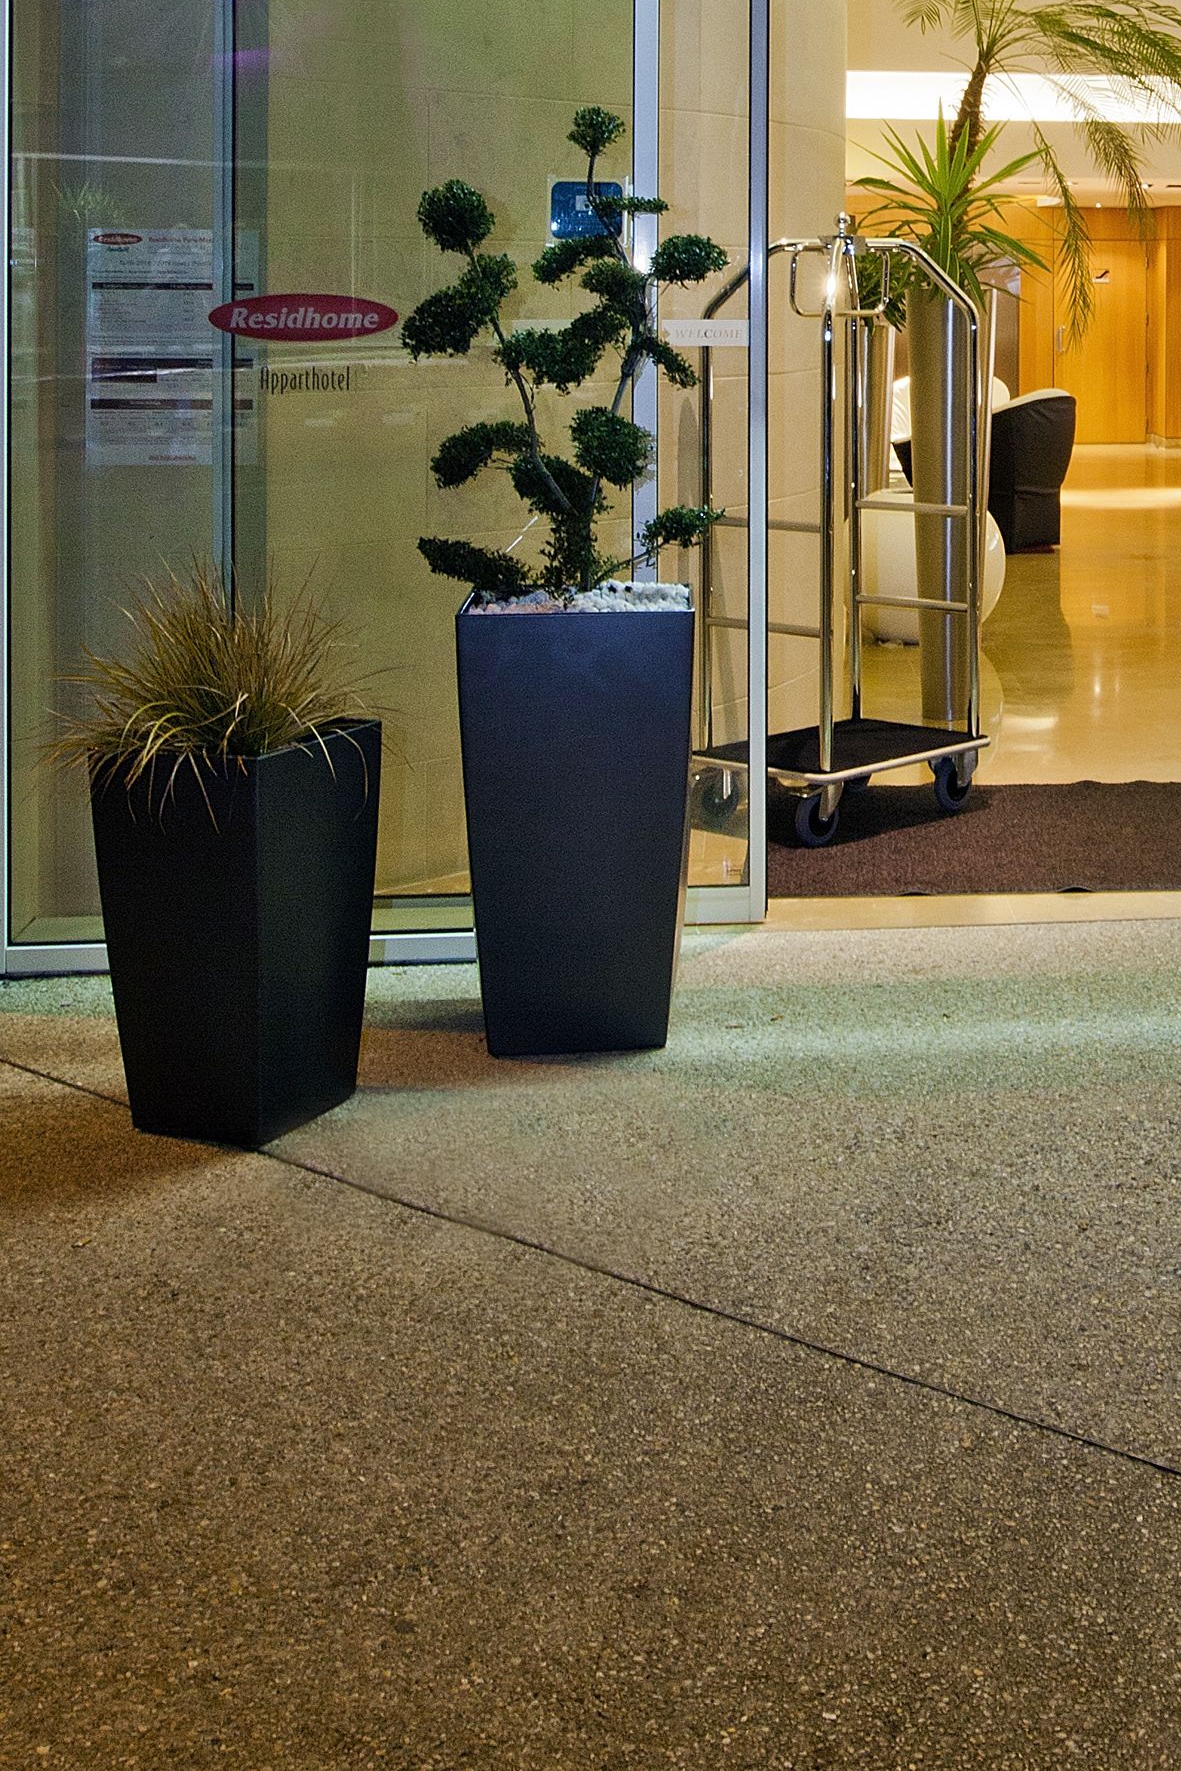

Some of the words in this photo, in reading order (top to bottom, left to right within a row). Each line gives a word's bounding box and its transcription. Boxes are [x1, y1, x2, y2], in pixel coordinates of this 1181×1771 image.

[229, 307, 380, 329] Residhome
[675, 329, 743, 340] WELCOME
[260, 365, 351, 395] Apparthotel
